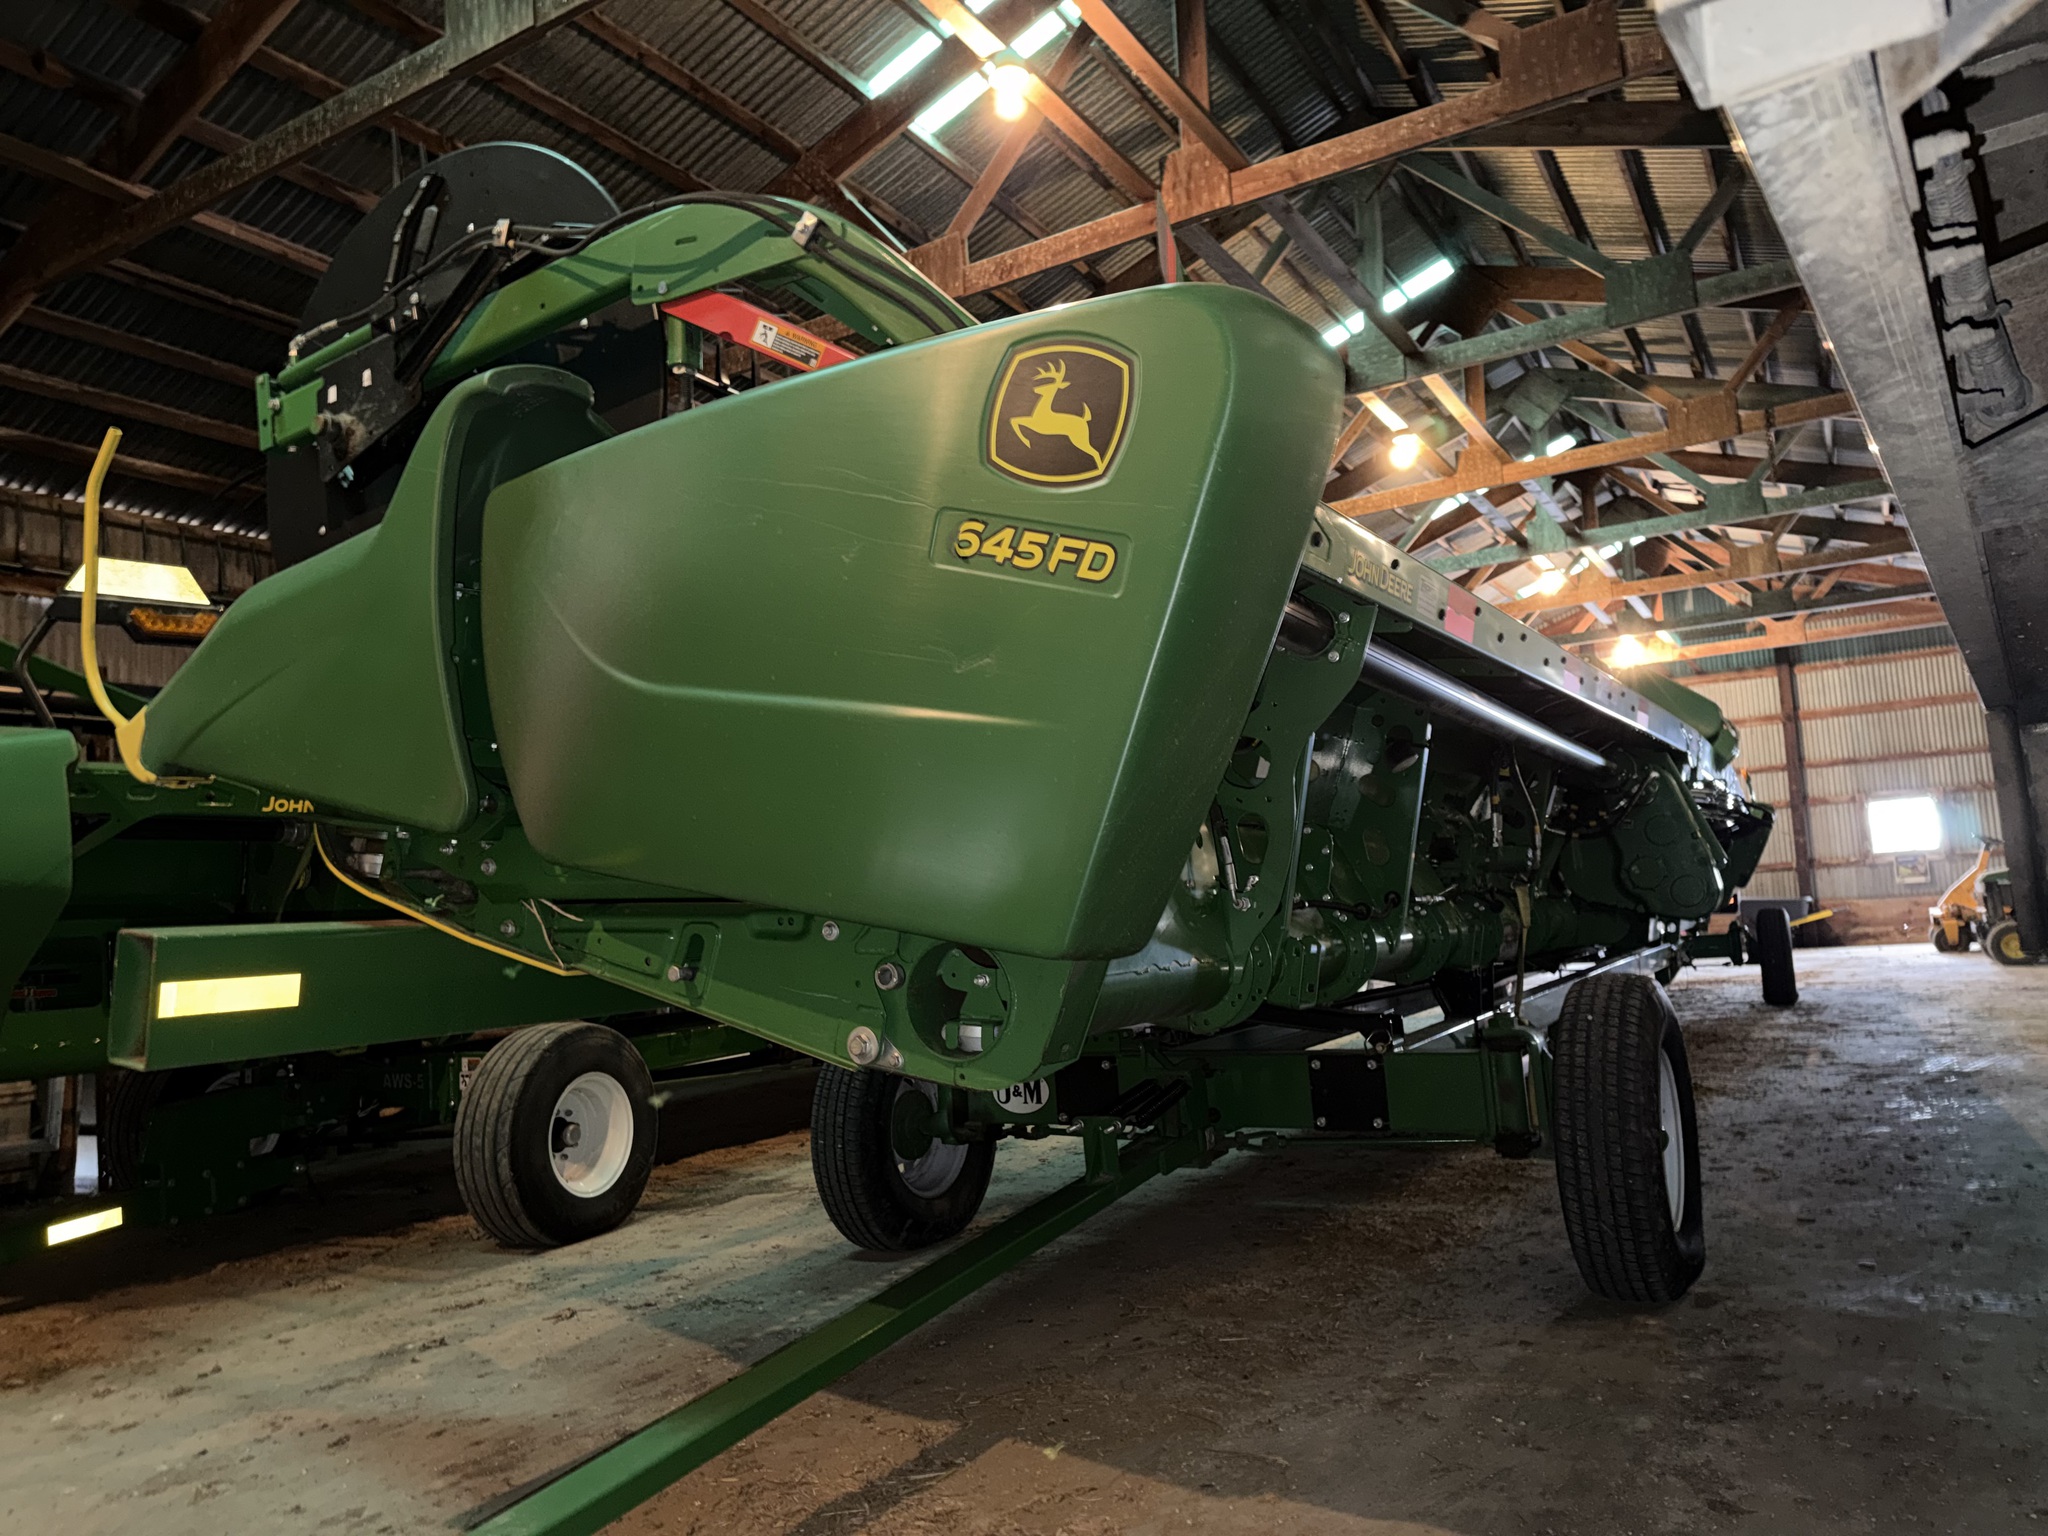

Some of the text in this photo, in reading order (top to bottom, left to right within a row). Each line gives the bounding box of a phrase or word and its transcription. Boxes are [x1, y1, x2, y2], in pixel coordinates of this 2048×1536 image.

[792, 332, 818, 348] WARNING
[954, 519, 1118, 582] 645FD
[1347, 548, 1380, 587] JOHN
[1380, 564, 1414, 605] DEERE
